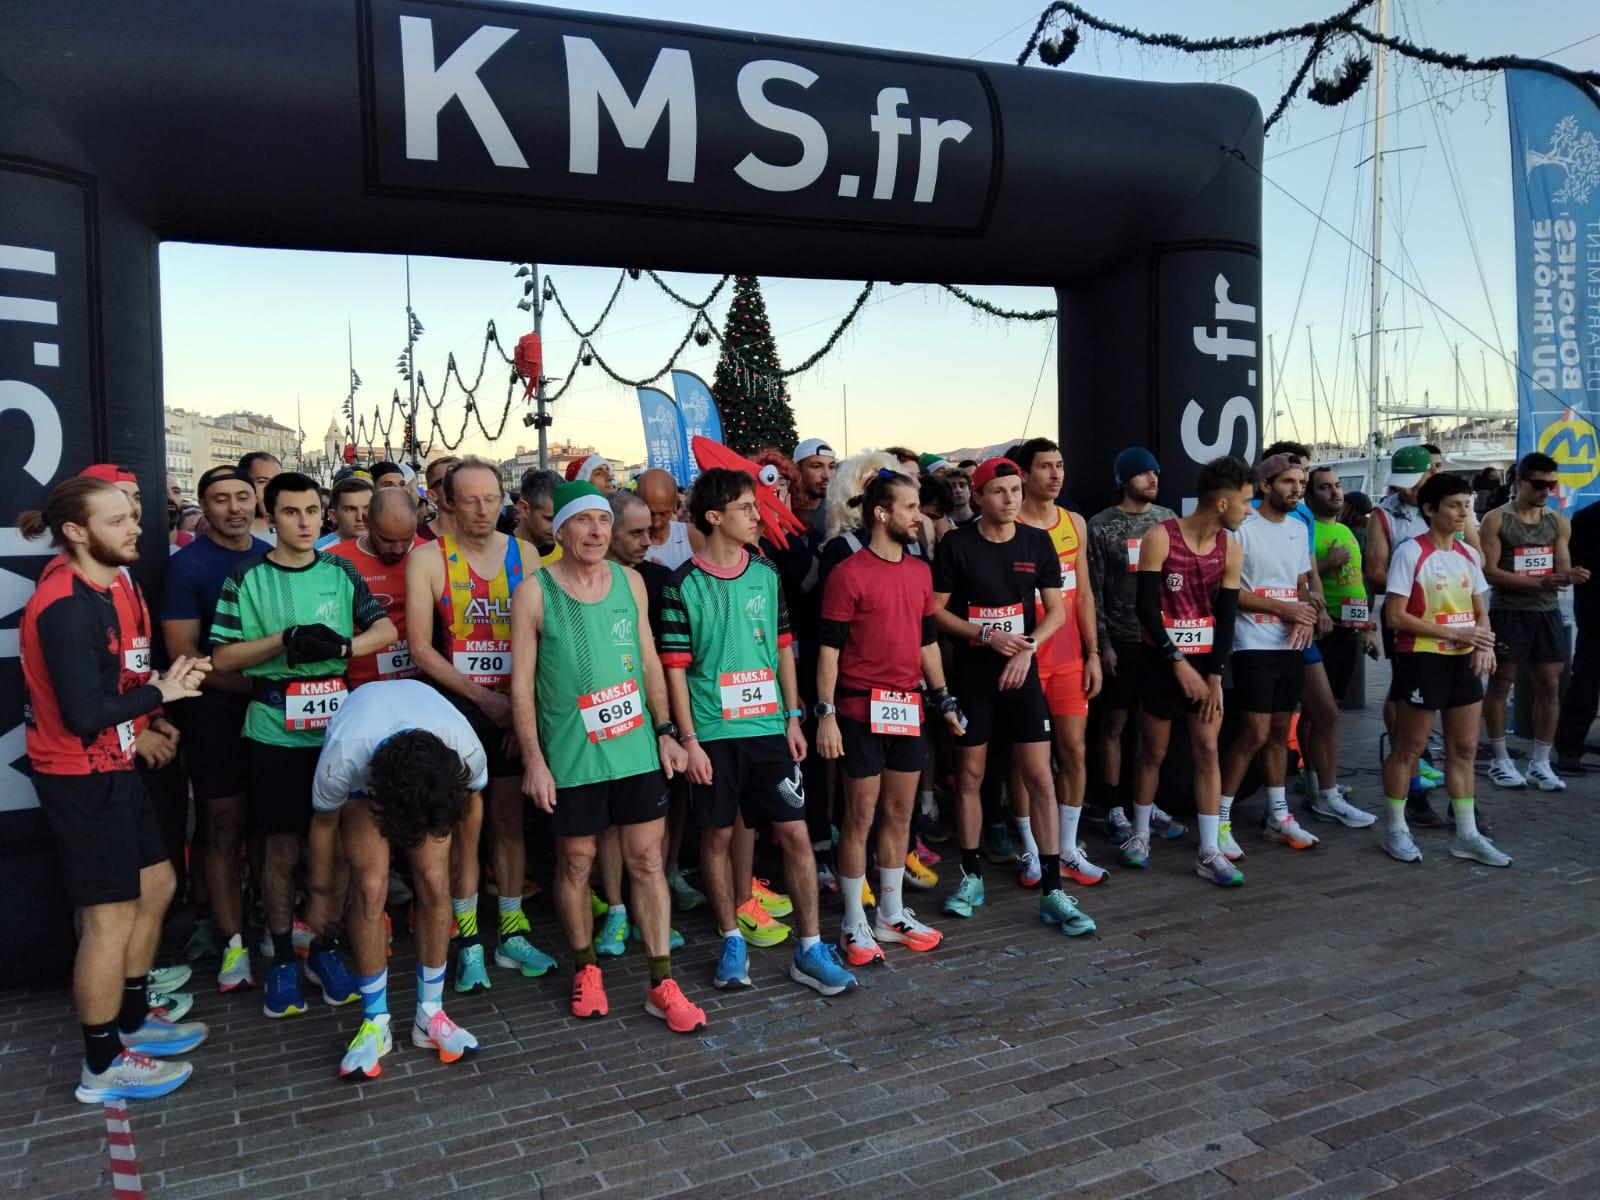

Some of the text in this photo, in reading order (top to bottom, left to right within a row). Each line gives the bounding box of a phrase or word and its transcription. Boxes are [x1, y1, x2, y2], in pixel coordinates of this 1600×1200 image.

[400, 15, 973, 203] KMS.fr
[1181, 272, 1256, 478] S.fr
[1525, 557, 1547, 567] 552
[1264, 588, 1295, 598] KMS.fr
[980, 606, 1017, 618] KMS.fr
[1173, 618, 1208, 628] KMS.fr
[1174, 632, 1202, 643] 731
[466, 640, 508, 652] KMS.fr
[467, 656, 503, 671] 780
[473, 675, 500, 684] KMS.fr
[732, 670, 768, 684] KMS.fr
[591, 682, 633, 705] KMS.fr
[742, 687, 762, 703] 54
[302, 697, 339, 715] 416
[598, 700, 633, 724] 698
[743, 706, 767, 716] KMS.fr
[881, 706, 907, 721] 281
[610, 720, 635, 735] KMS.fr
